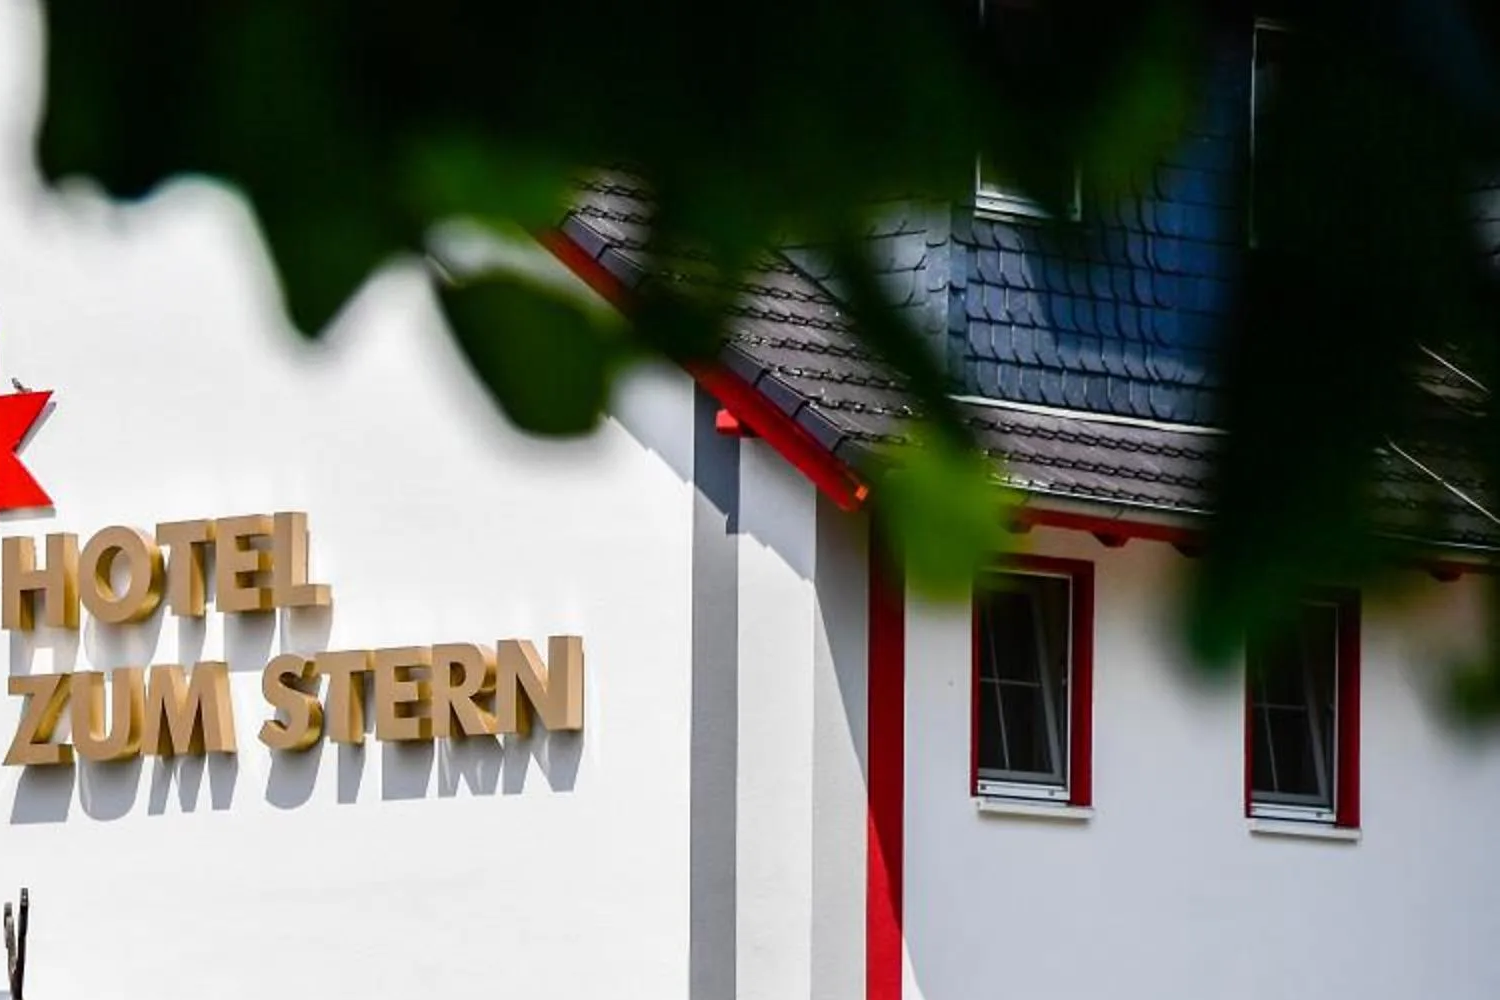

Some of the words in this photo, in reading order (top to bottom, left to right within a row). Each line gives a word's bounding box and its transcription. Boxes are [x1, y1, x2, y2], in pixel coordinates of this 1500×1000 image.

[2, 511, 332, 631] HOTEL
[3, 660, 237, 766] ZUM
[259, 635, 583, 751] STERN
